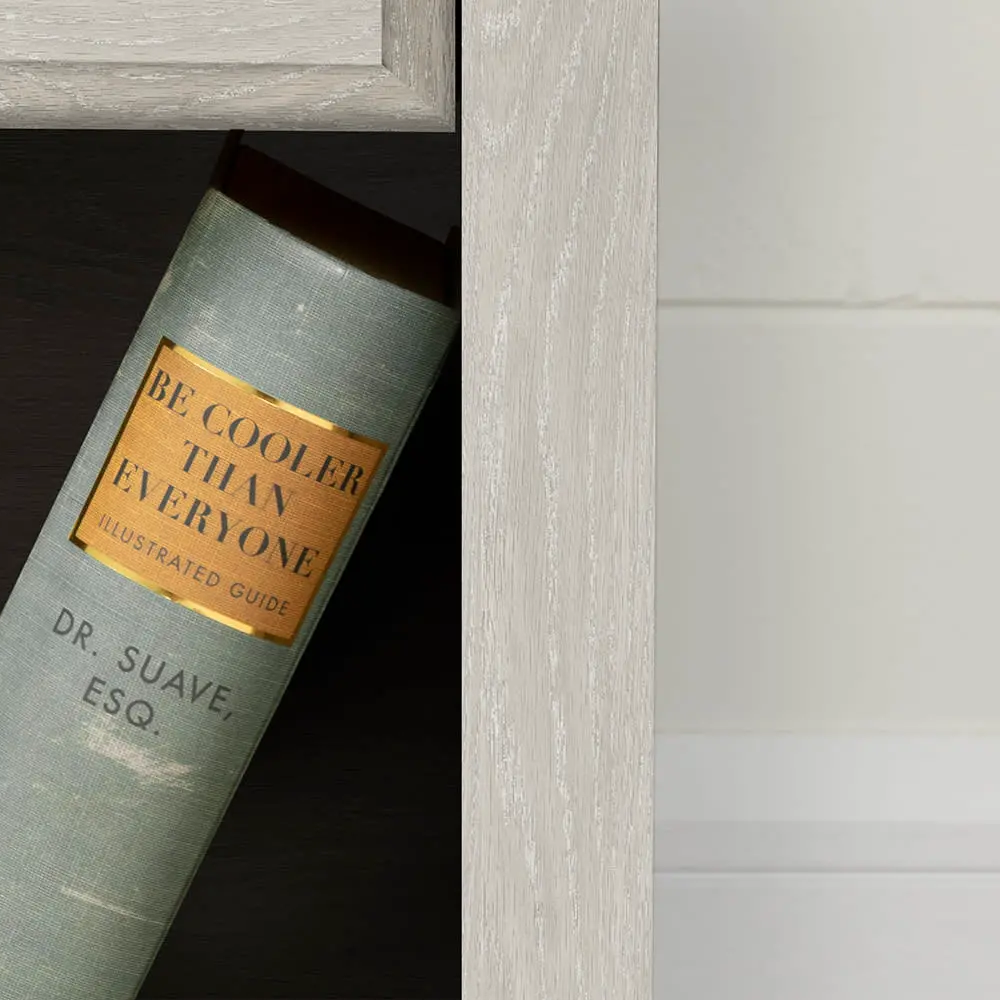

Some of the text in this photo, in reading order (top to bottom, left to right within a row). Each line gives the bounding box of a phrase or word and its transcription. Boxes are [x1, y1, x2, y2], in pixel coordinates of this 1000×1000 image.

[147, 368, 365, 496] BE COOLER
[182, 439, 296, 518] THAN
[98, 513, 291, 617] ILLUSTRATED GUIDE
[112, 457, 320, 579] EVERYONE
[52, 607, 232, 721] DR. SUAVE,
[82, 676, 160, 736] ESQ.
